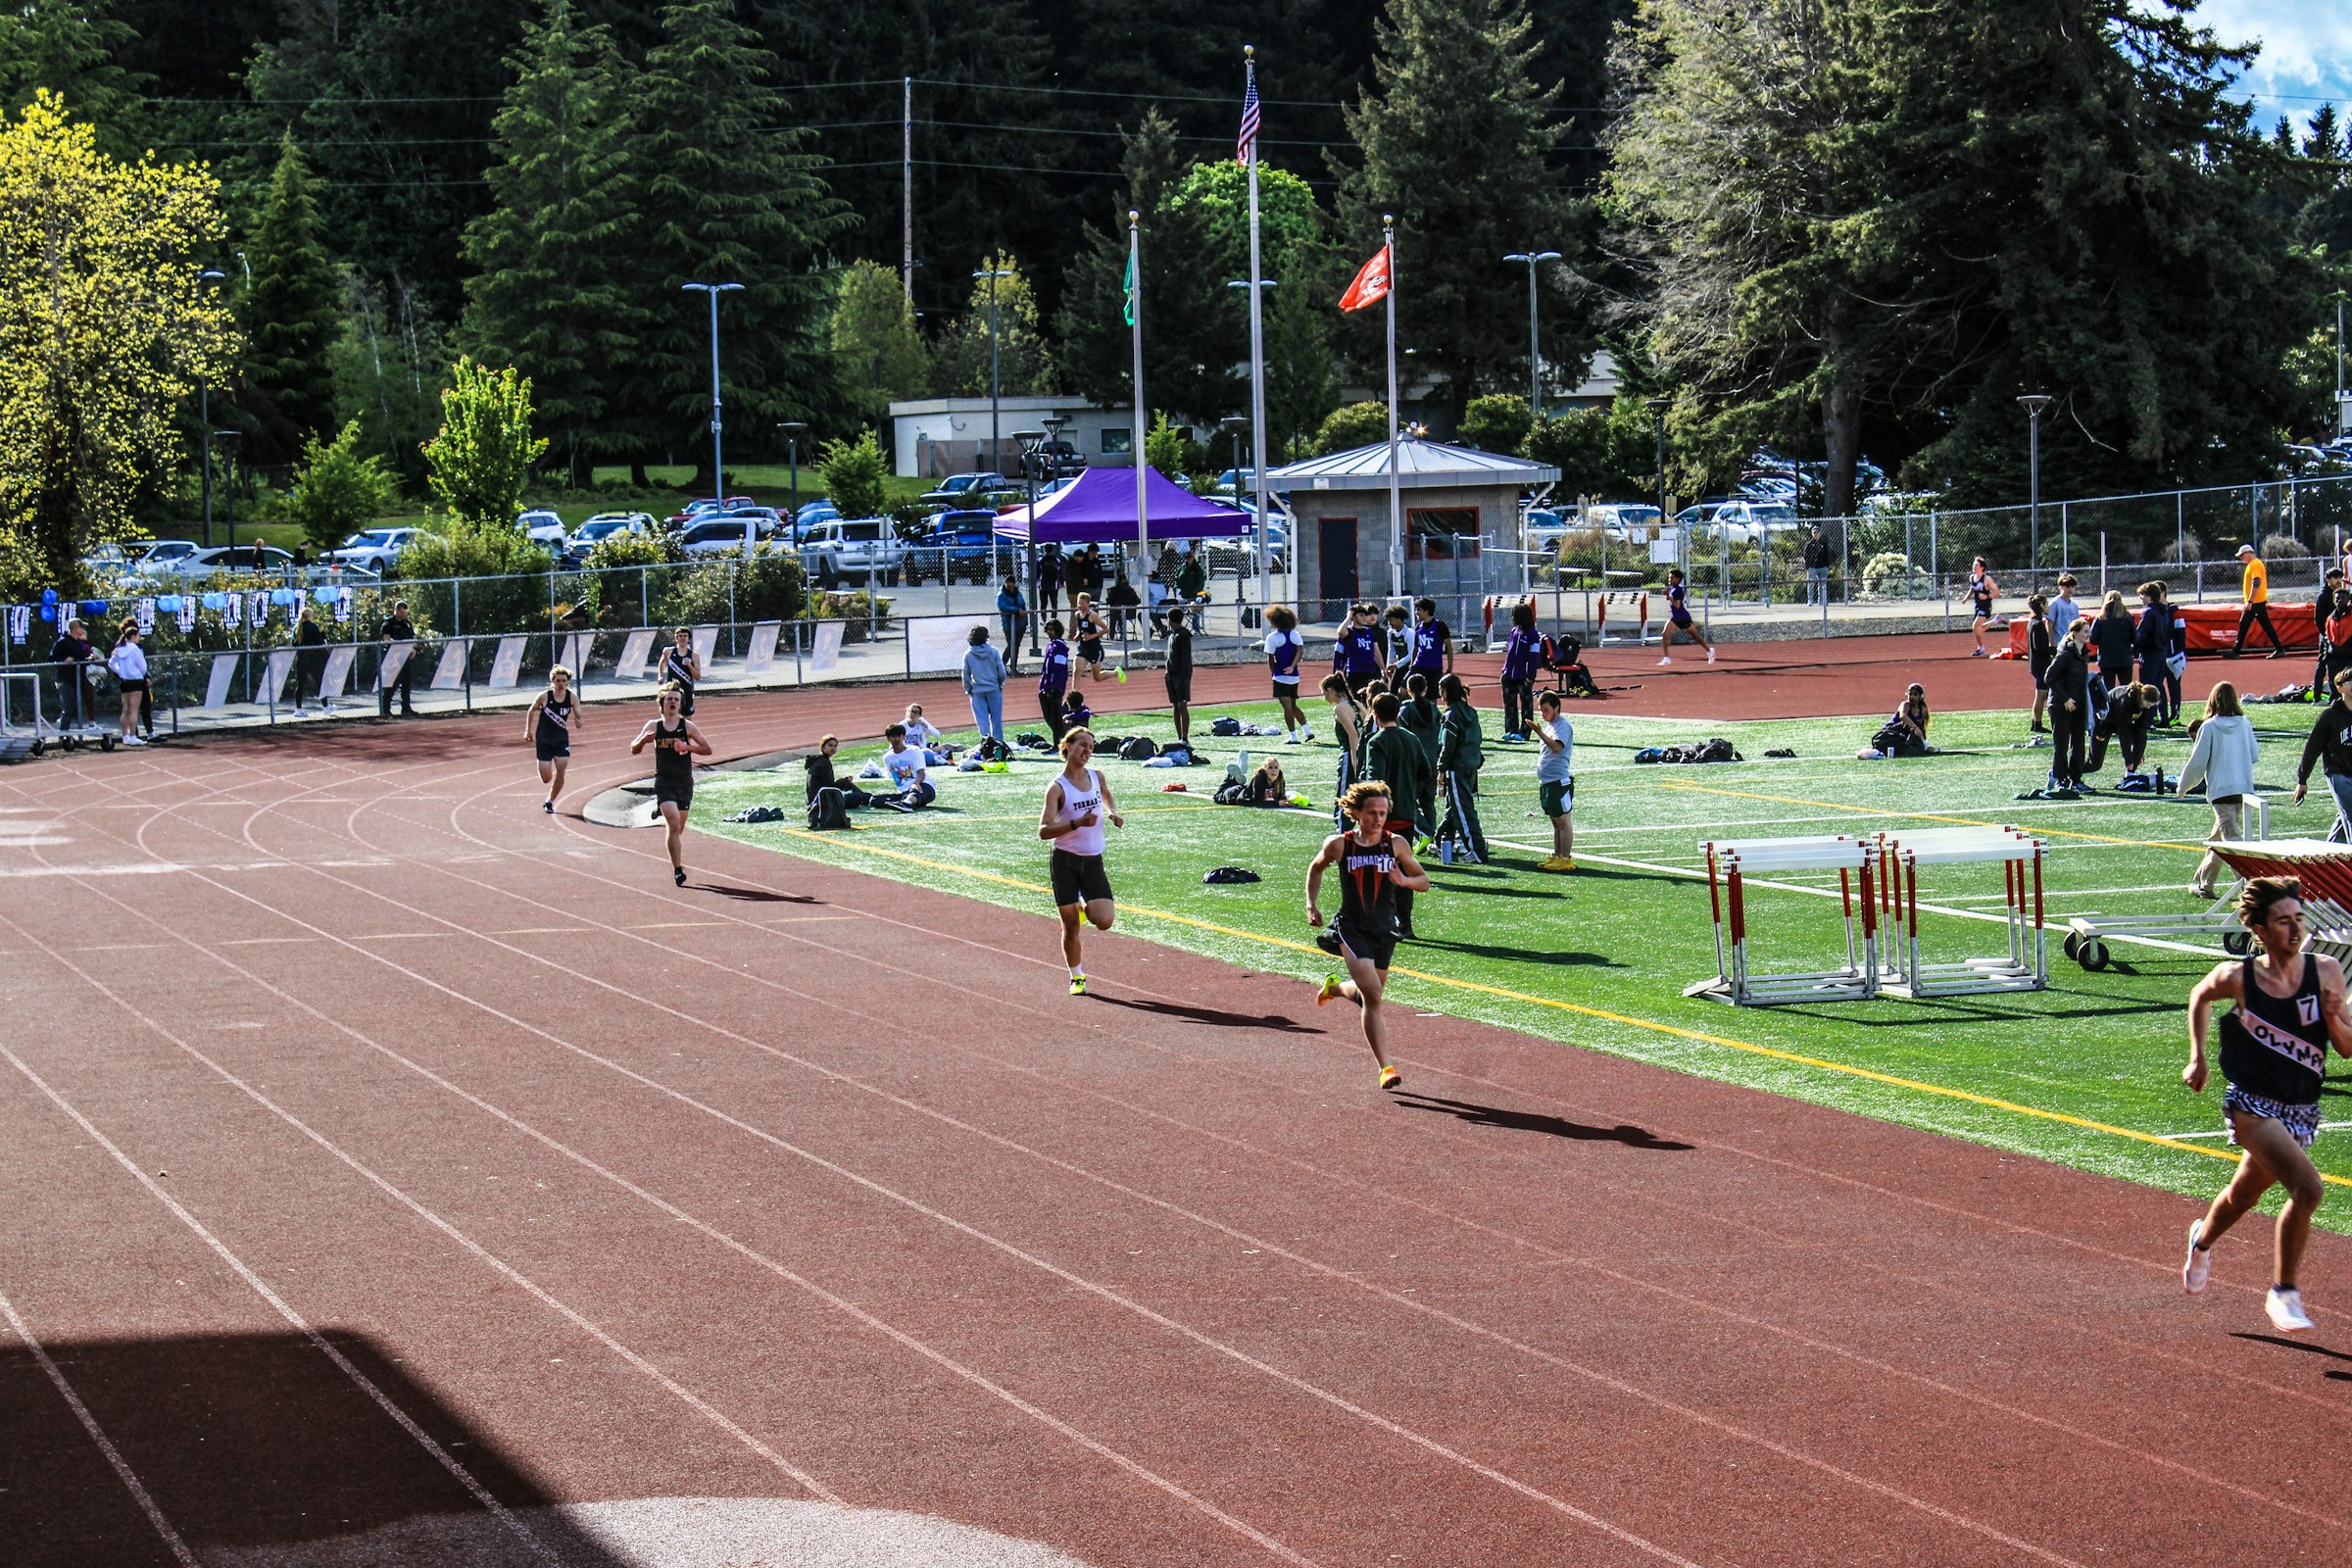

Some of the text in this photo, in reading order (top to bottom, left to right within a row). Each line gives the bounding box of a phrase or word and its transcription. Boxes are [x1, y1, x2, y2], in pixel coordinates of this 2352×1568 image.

[1357, 637, 1371, 651] NT
[1418, 633, 1434, 650] NT
[2300, 998, 2315, 1021] 7
